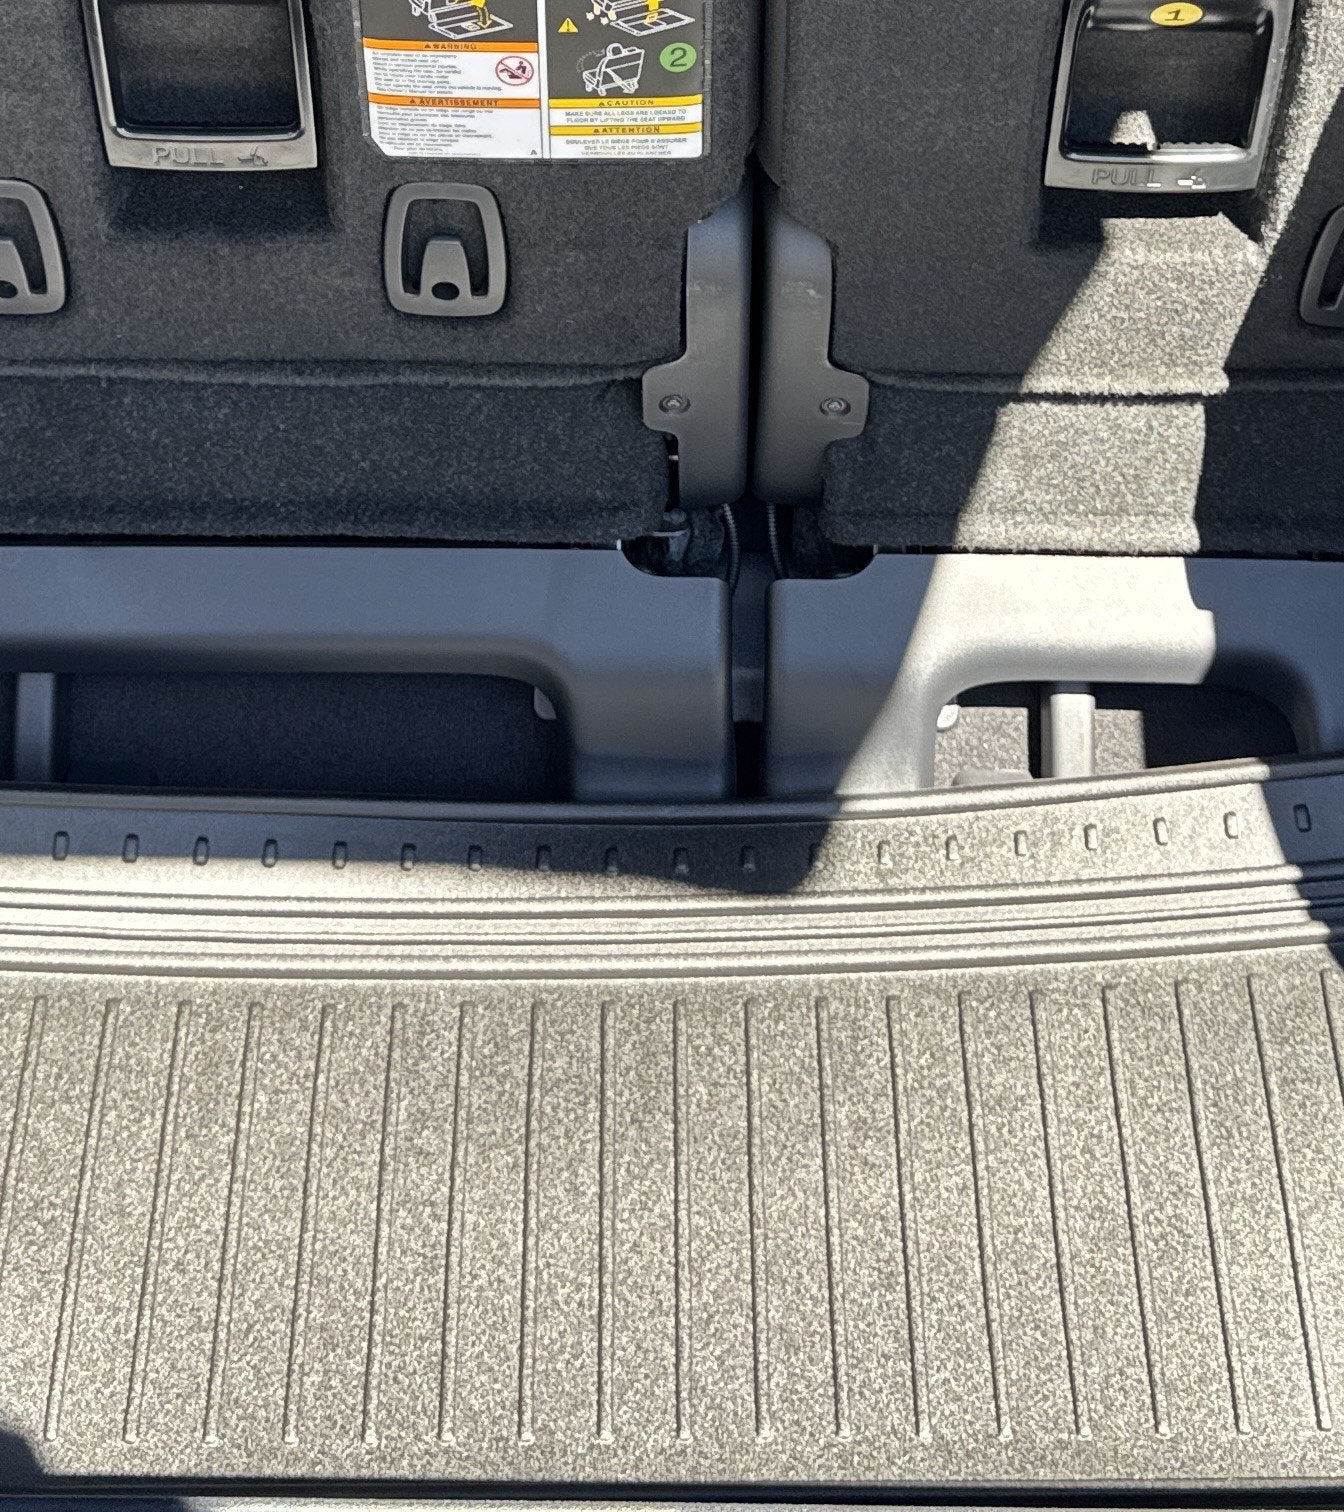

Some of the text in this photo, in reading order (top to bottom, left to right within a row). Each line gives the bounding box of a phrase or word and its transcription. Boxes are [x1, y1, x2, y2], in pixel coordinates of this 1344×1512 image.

[669, 46, 688, 68] 2
[602, 126, 660, 134] ATTENTION
[152, 146, 226, 168] PULL
[1091, 167, 1162, 188] PULL
